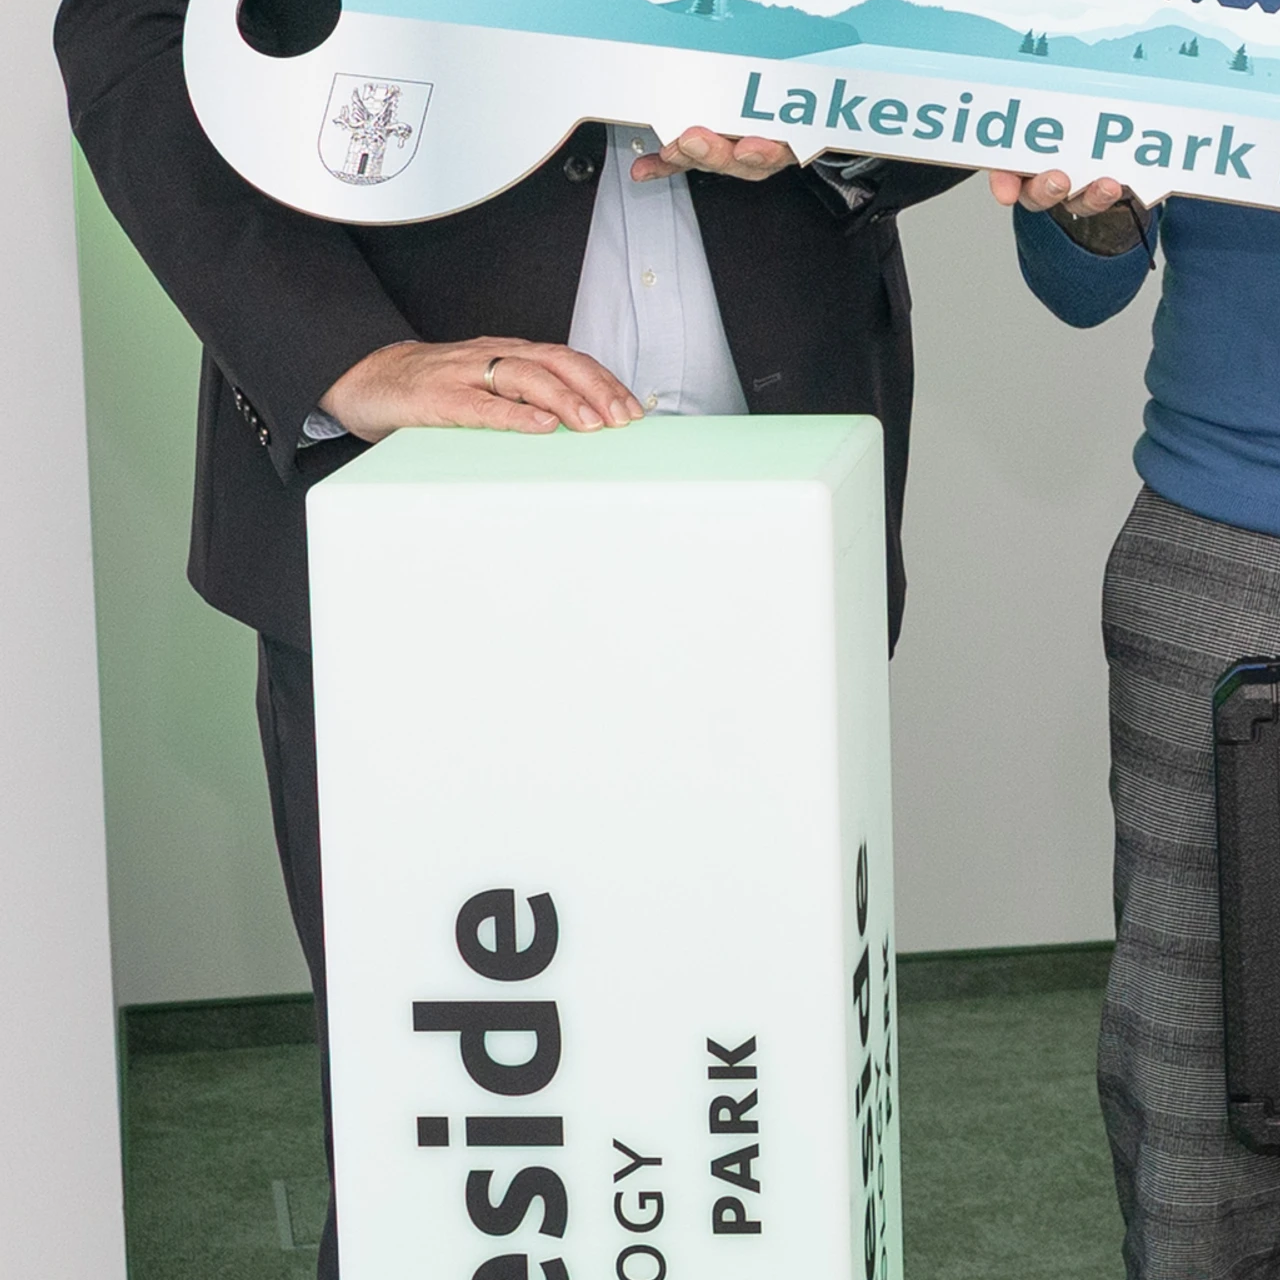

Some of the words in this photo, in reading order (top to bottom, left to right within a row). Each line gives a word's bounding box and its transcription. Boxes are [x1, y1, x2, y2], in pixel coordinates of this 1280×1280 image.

[741, 72, 1064, 154] Lakeside
[1092, 112, 1253, 178] Park
[881, 933, 893, 1127] PARK
[706, 1035, 762, 1235] PARK
